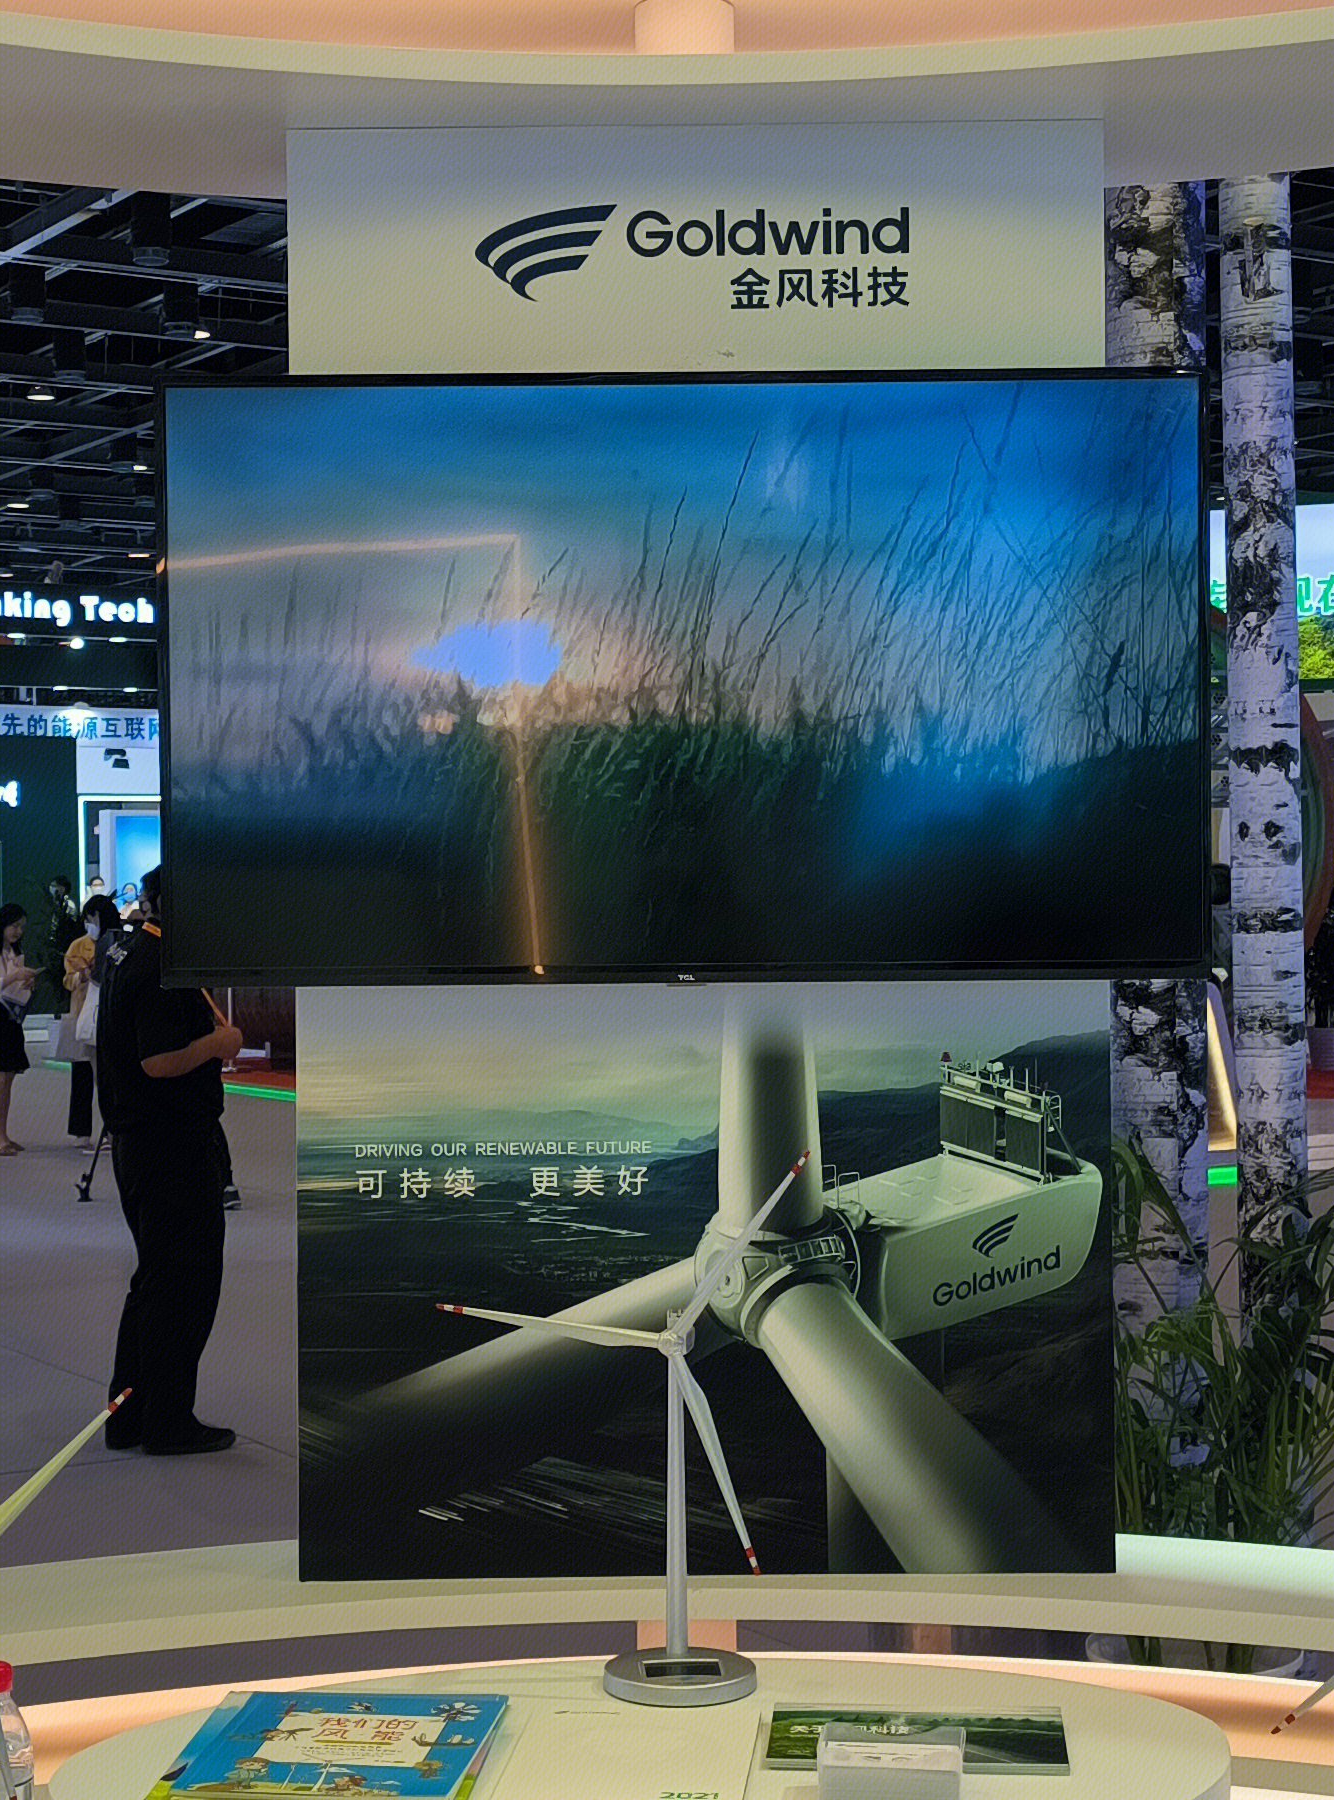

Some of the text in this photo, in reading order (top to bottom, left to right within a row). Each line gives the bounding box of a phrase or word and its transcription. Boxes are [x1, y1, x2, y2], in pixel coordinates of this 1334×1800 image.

[626, 207, 910, 258] Goldwind
[731, 266, 910, 309] 金风科技
[79, 595, 154, 624] Tech
[355, 1140, 651, 1158] DRIVING OUR RENEWABLE FUTURE
[356, 1165, 649, 1199] 可持续 更美好
[932, 1245, 1061, 1307] Goldwind
[319, 1717, 419, 1730] 我们的
